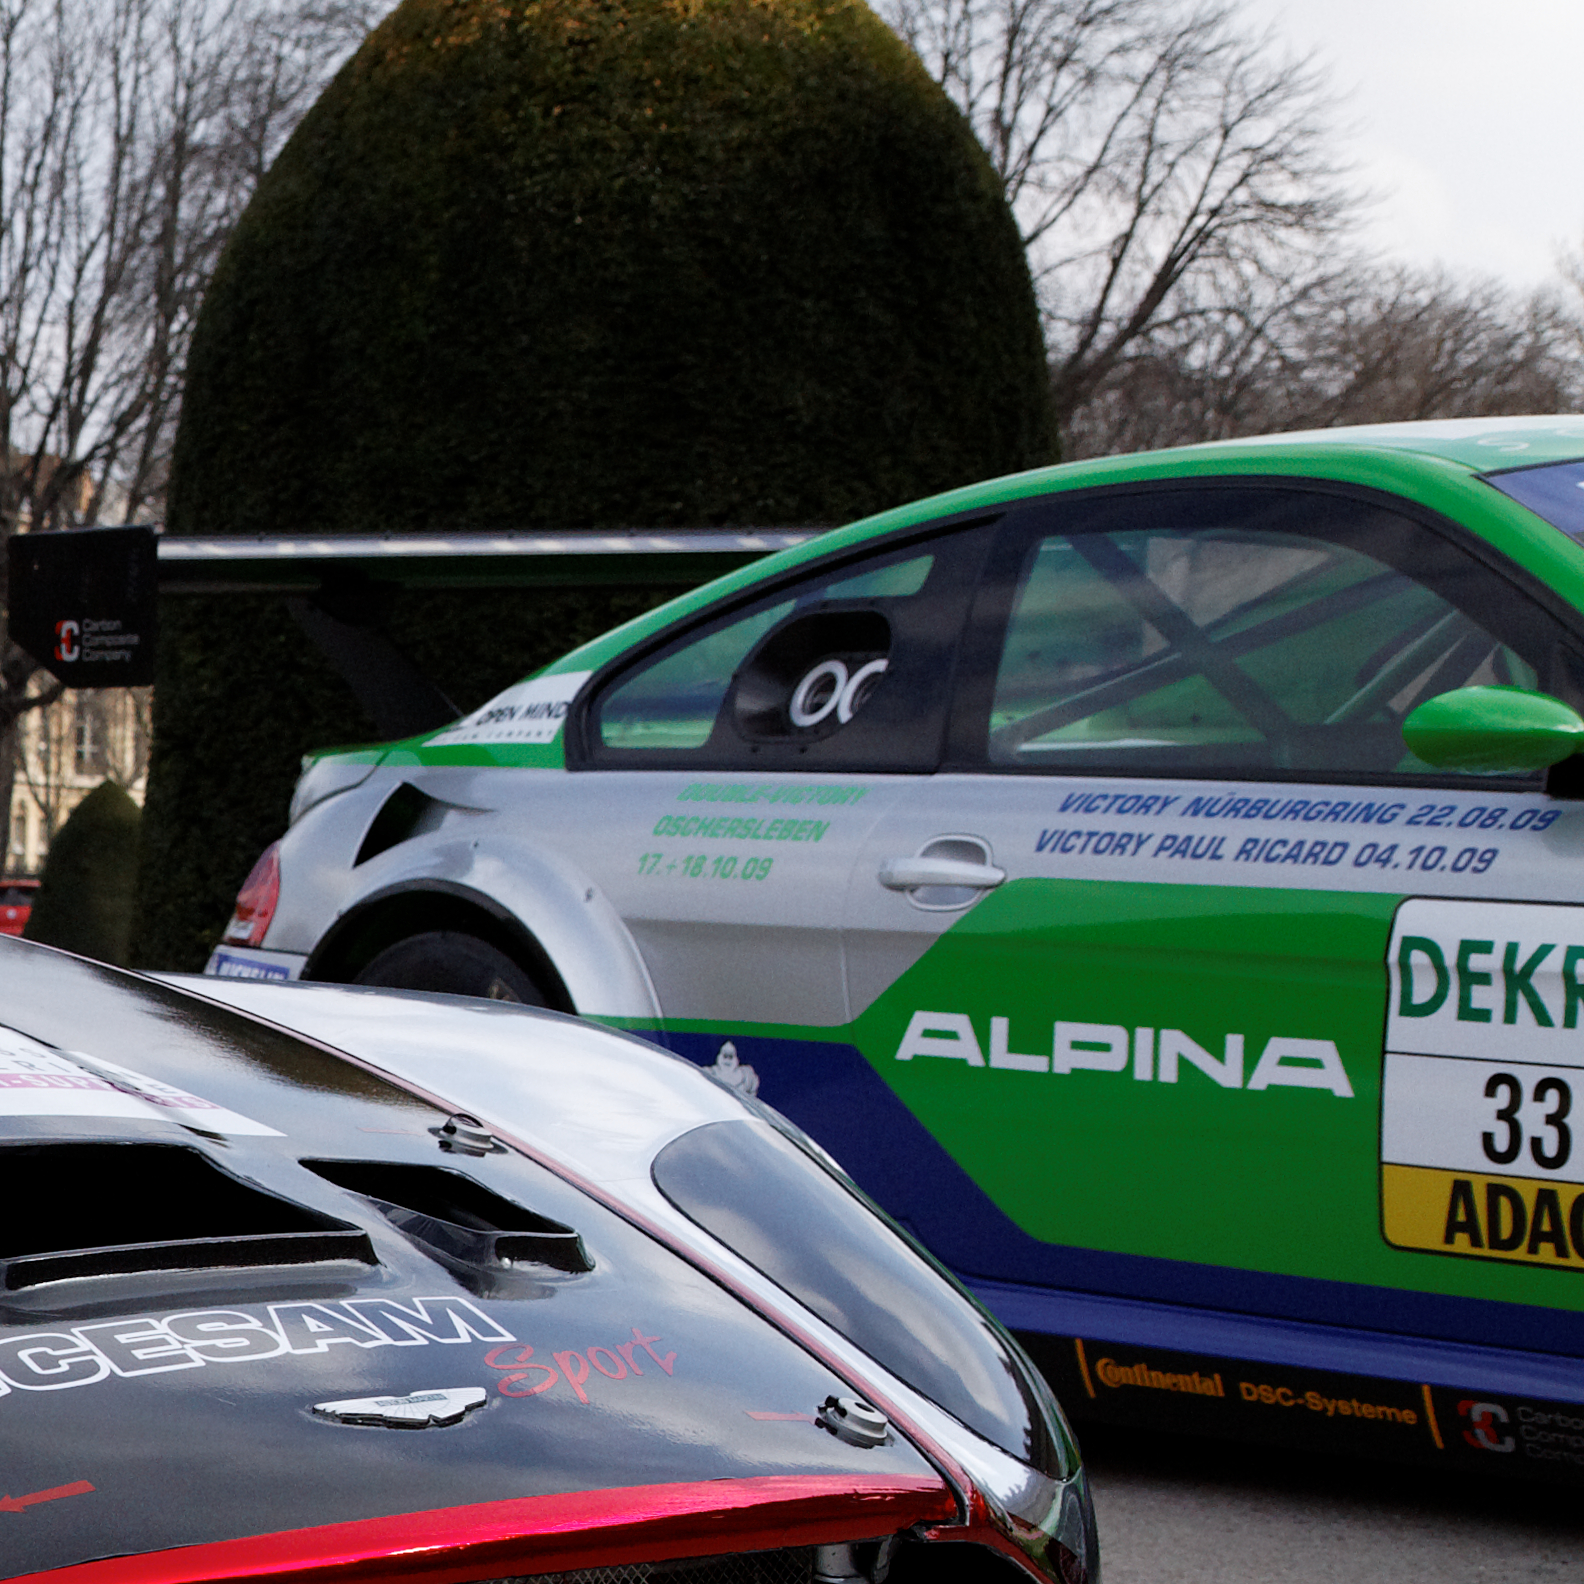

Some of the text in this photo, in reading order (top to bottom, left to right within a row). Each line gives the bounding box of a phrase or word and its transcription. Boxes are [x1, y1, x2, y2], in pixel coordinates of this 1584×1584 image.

[652, 814, 831, 843] OSCHERSLEBEN
[1056, 791, 1181, 817] VICTORY
[1404, 803, 1563, 832] 22.08.09
[1034, 829, 1501, 875] VICTORY PAUL RICARD 04.10.09
[894, 1009, 1355, 1099] ALPINA
[1480, 1072, 1573, 1171] 33
[484, 1326, 679, 1405] Sport
[1095, 1357, 1226, 1398] Continental
[1239, 1381, 1418, 1425] DSC-Systeme
